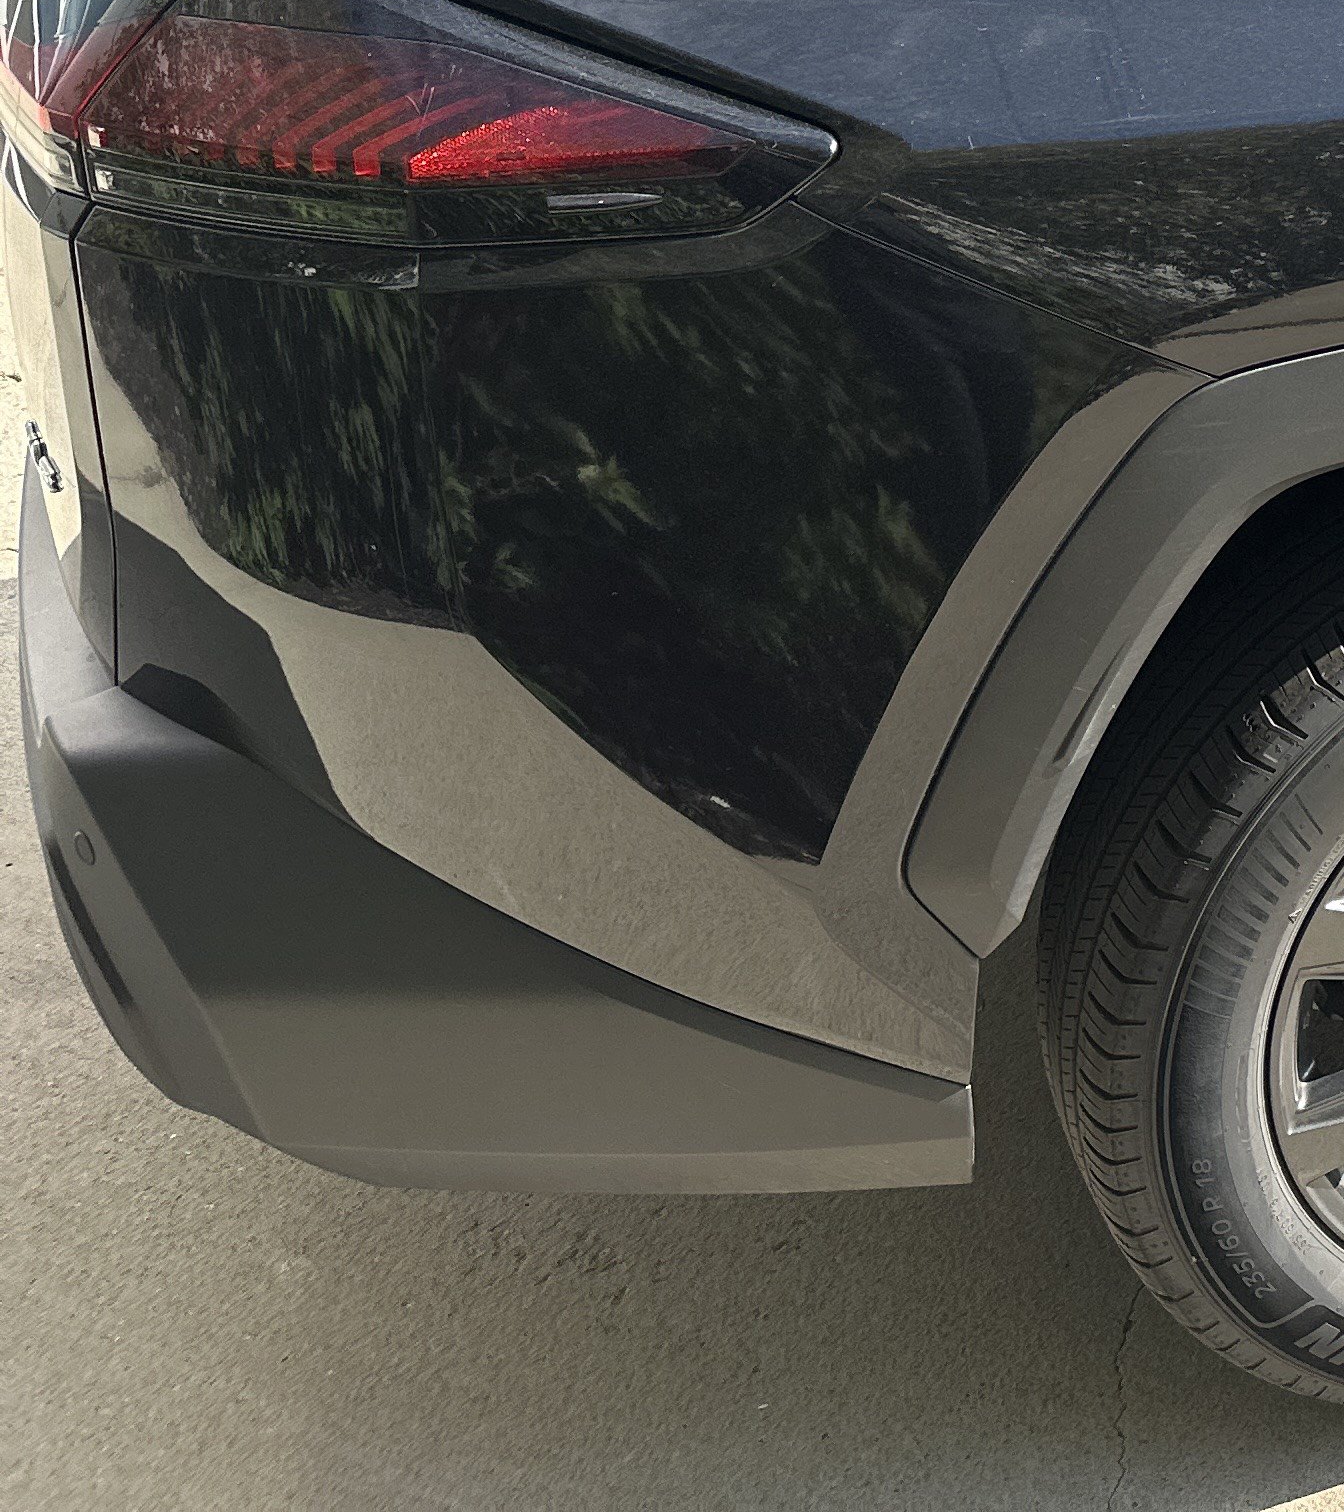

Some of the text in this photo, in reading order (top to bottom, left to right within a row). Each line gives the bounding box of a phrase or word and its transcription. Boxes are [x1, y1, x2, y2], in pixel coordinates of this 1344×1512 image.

[1191, 1159, 1277, 1299] 235/60 R 18
